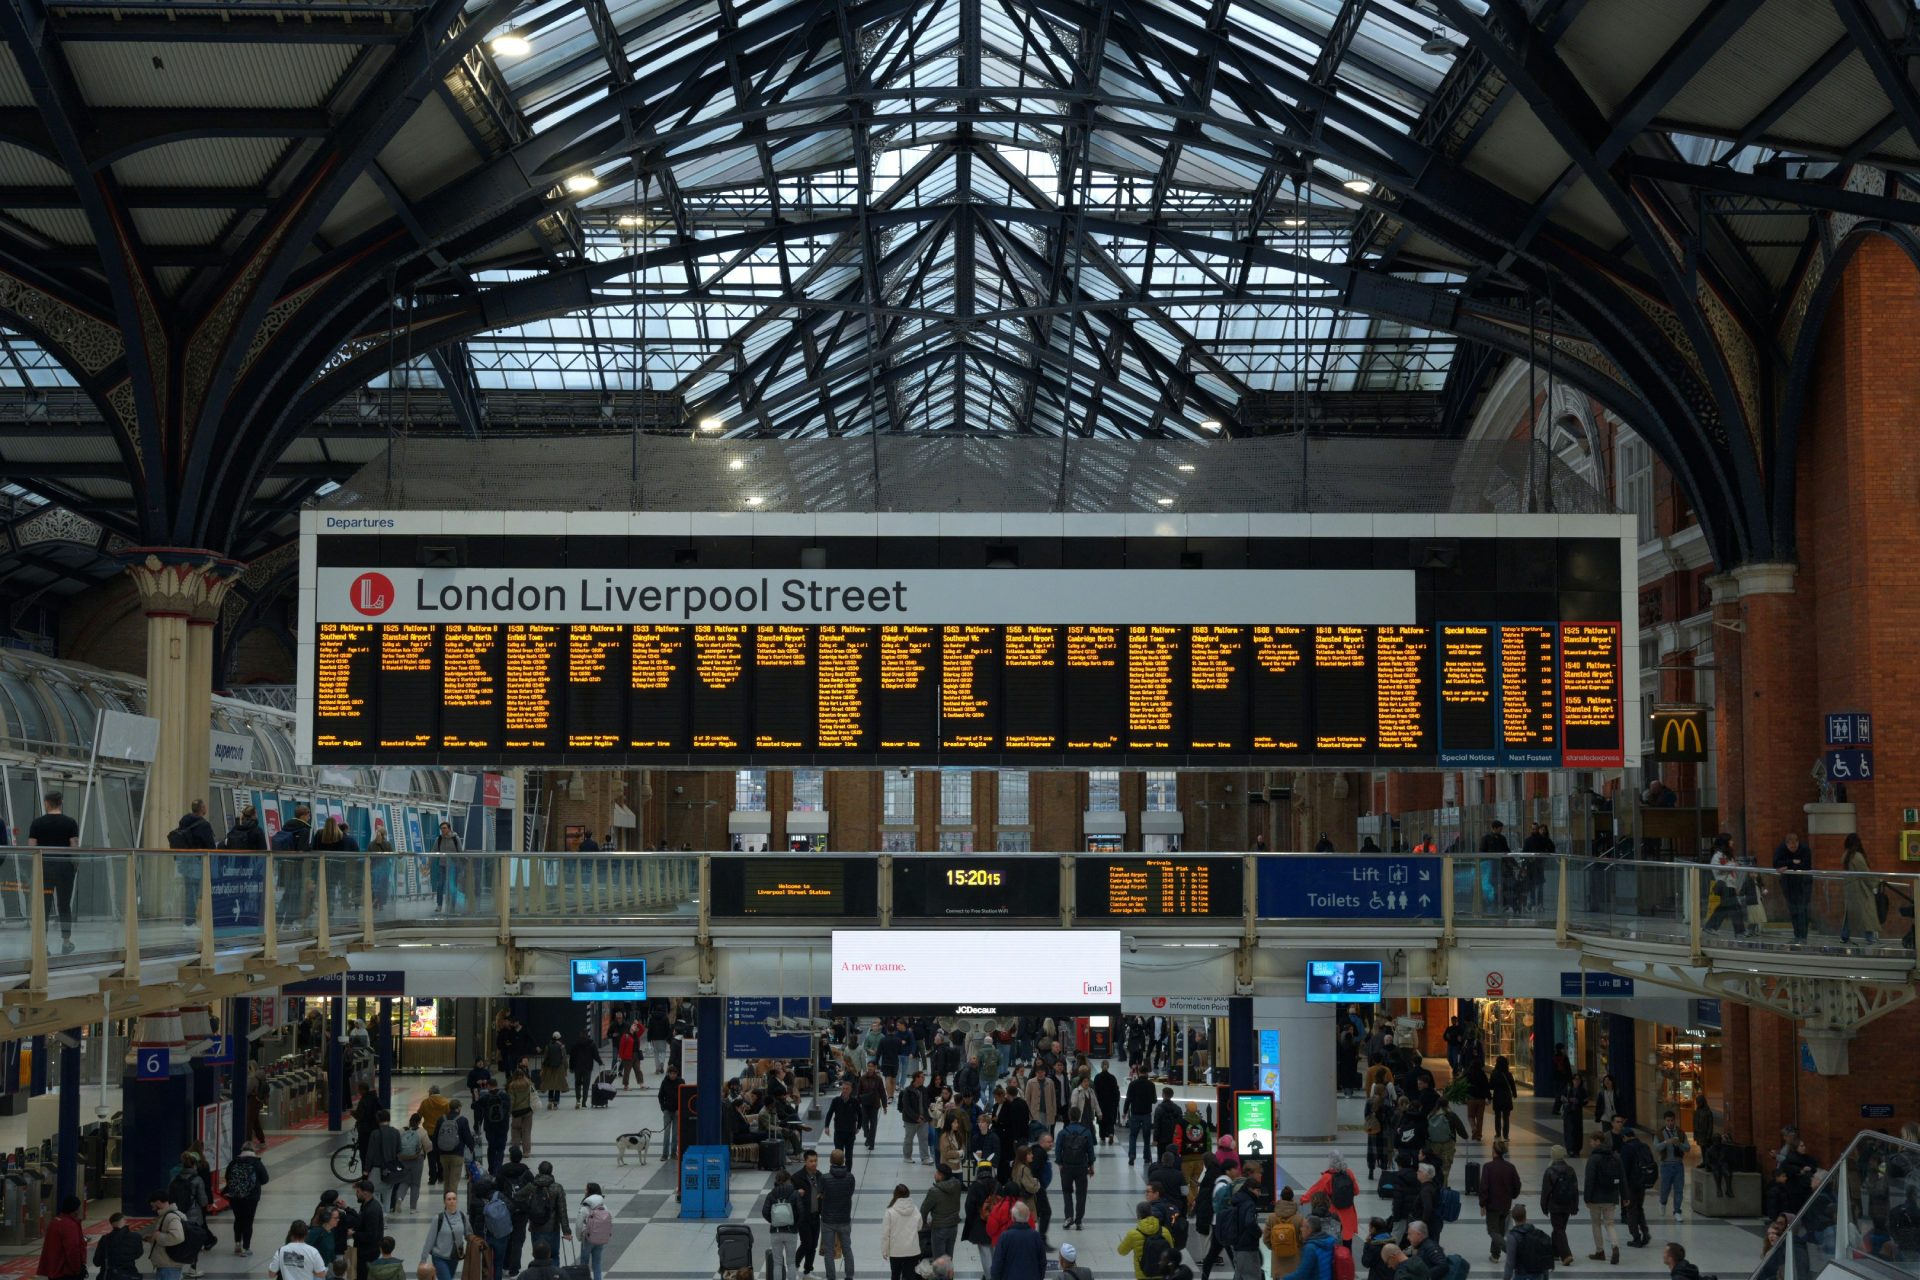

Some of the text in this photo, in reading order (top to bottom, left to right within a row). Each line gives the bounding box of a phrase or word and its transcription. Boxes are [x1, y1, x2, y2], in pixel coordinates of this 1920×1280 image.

[326, 516, 394, 530] Departures
[416, 578, 566, 612] London
[580, 578, 768, 620] Liverpool
[780, 578, 907, 612] Street
[1445, 627, 1464, 635] Special
[1592, 636, 1612, 645] Airport
[1593, 671, 1612, 680] Airport
[1594, 706, 1613, 714] Airport
[1353, 867, 1380, 881] Lift
[1307, 893, 1360, 907] Toilets
[841, 962, 849, 971] A
[1170, 1002, 1210, 1010] Information
[146, 1053, 160, 1073] 6
